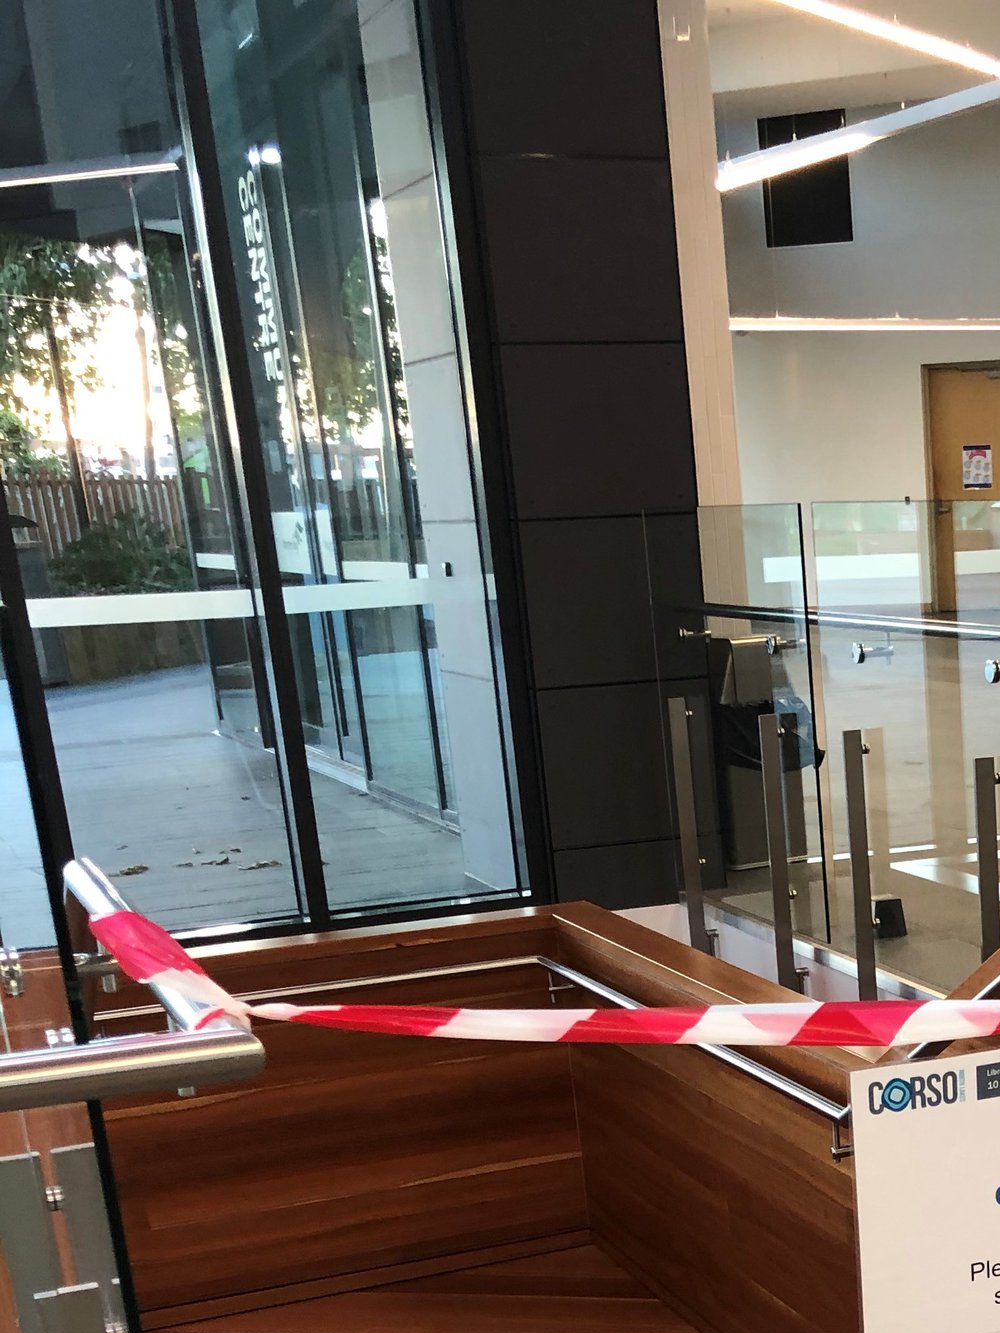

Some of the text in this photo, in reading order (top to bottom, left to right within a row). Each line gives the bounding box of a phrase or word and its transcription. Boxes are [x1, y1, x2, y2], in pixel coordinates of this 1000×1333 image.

[238, 176, 276, 382] CENTRE
[868, 1070, 958, 1115] CORSO
[987, 1080, 999, 1090] 10
